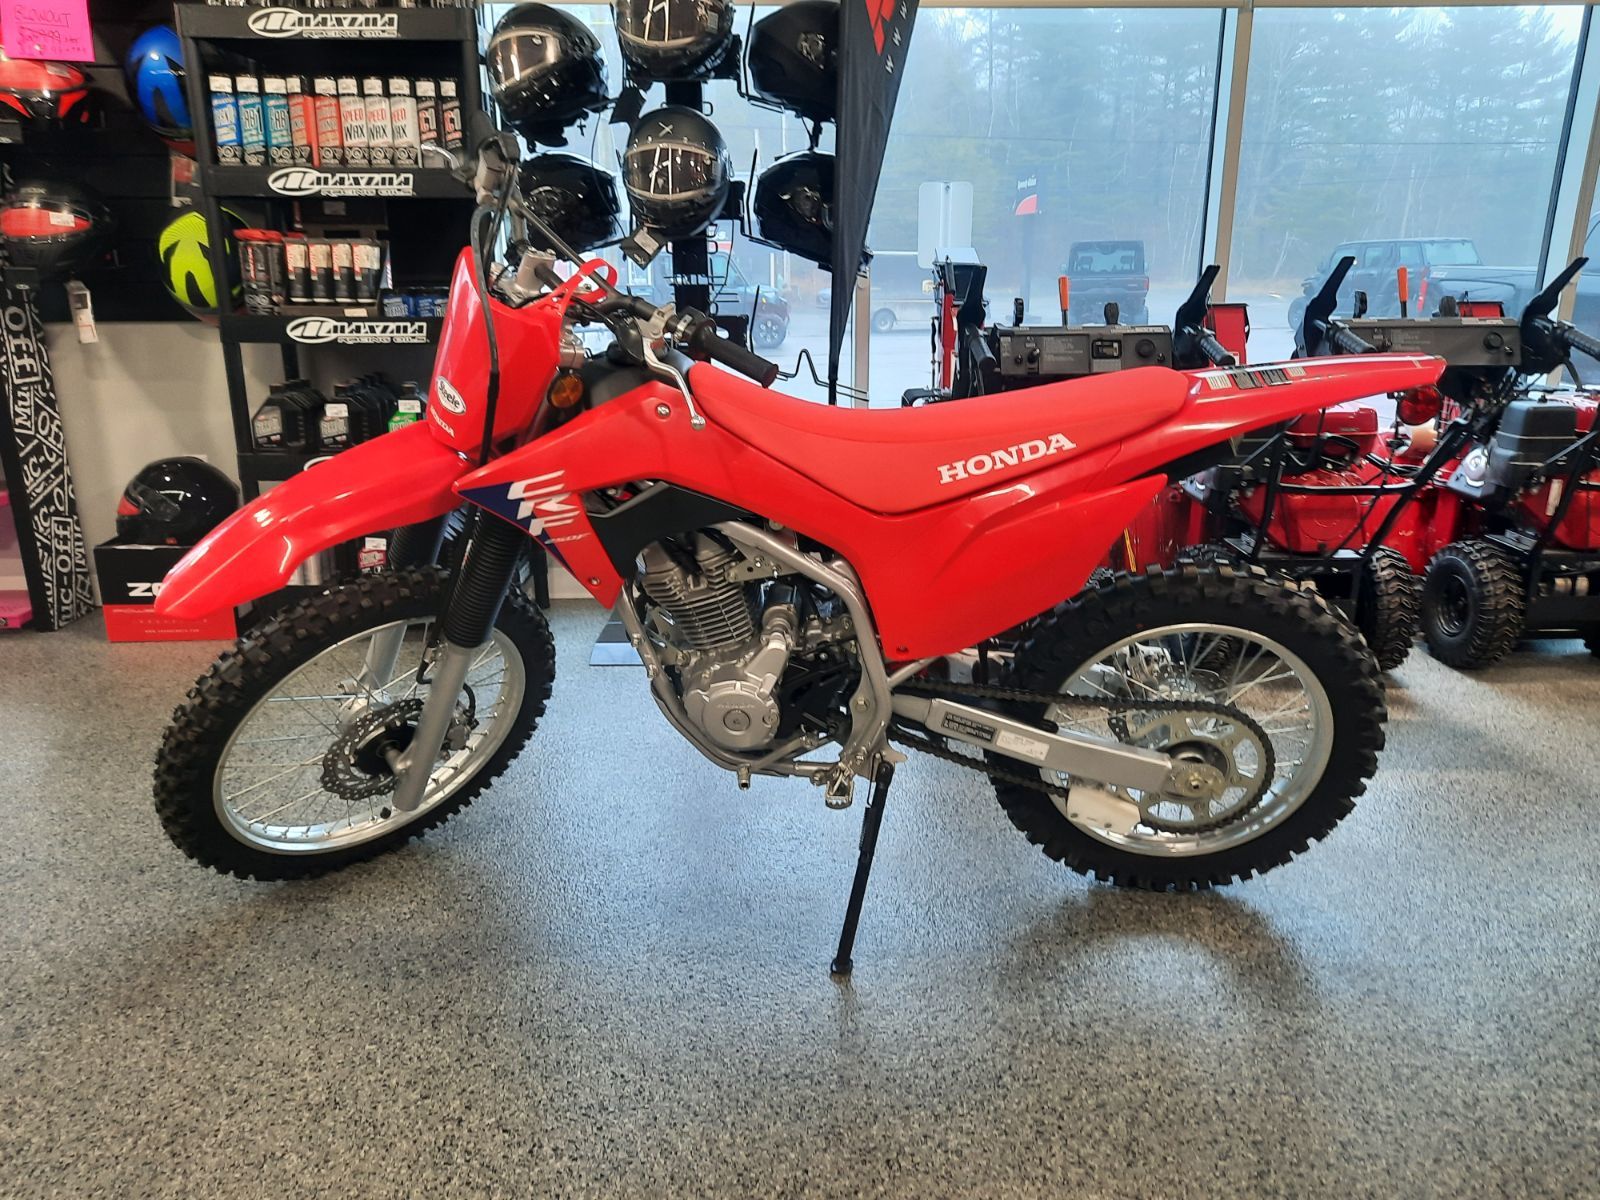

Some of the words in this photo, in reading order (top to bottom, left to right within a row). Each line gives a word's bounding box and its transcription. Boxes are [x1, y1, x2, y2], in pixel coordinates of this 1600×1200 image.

[344, 123, 366, 141] WAX
[937, 433, 1077, 484] HONDA
[507, 469, 581, 536] CRF
